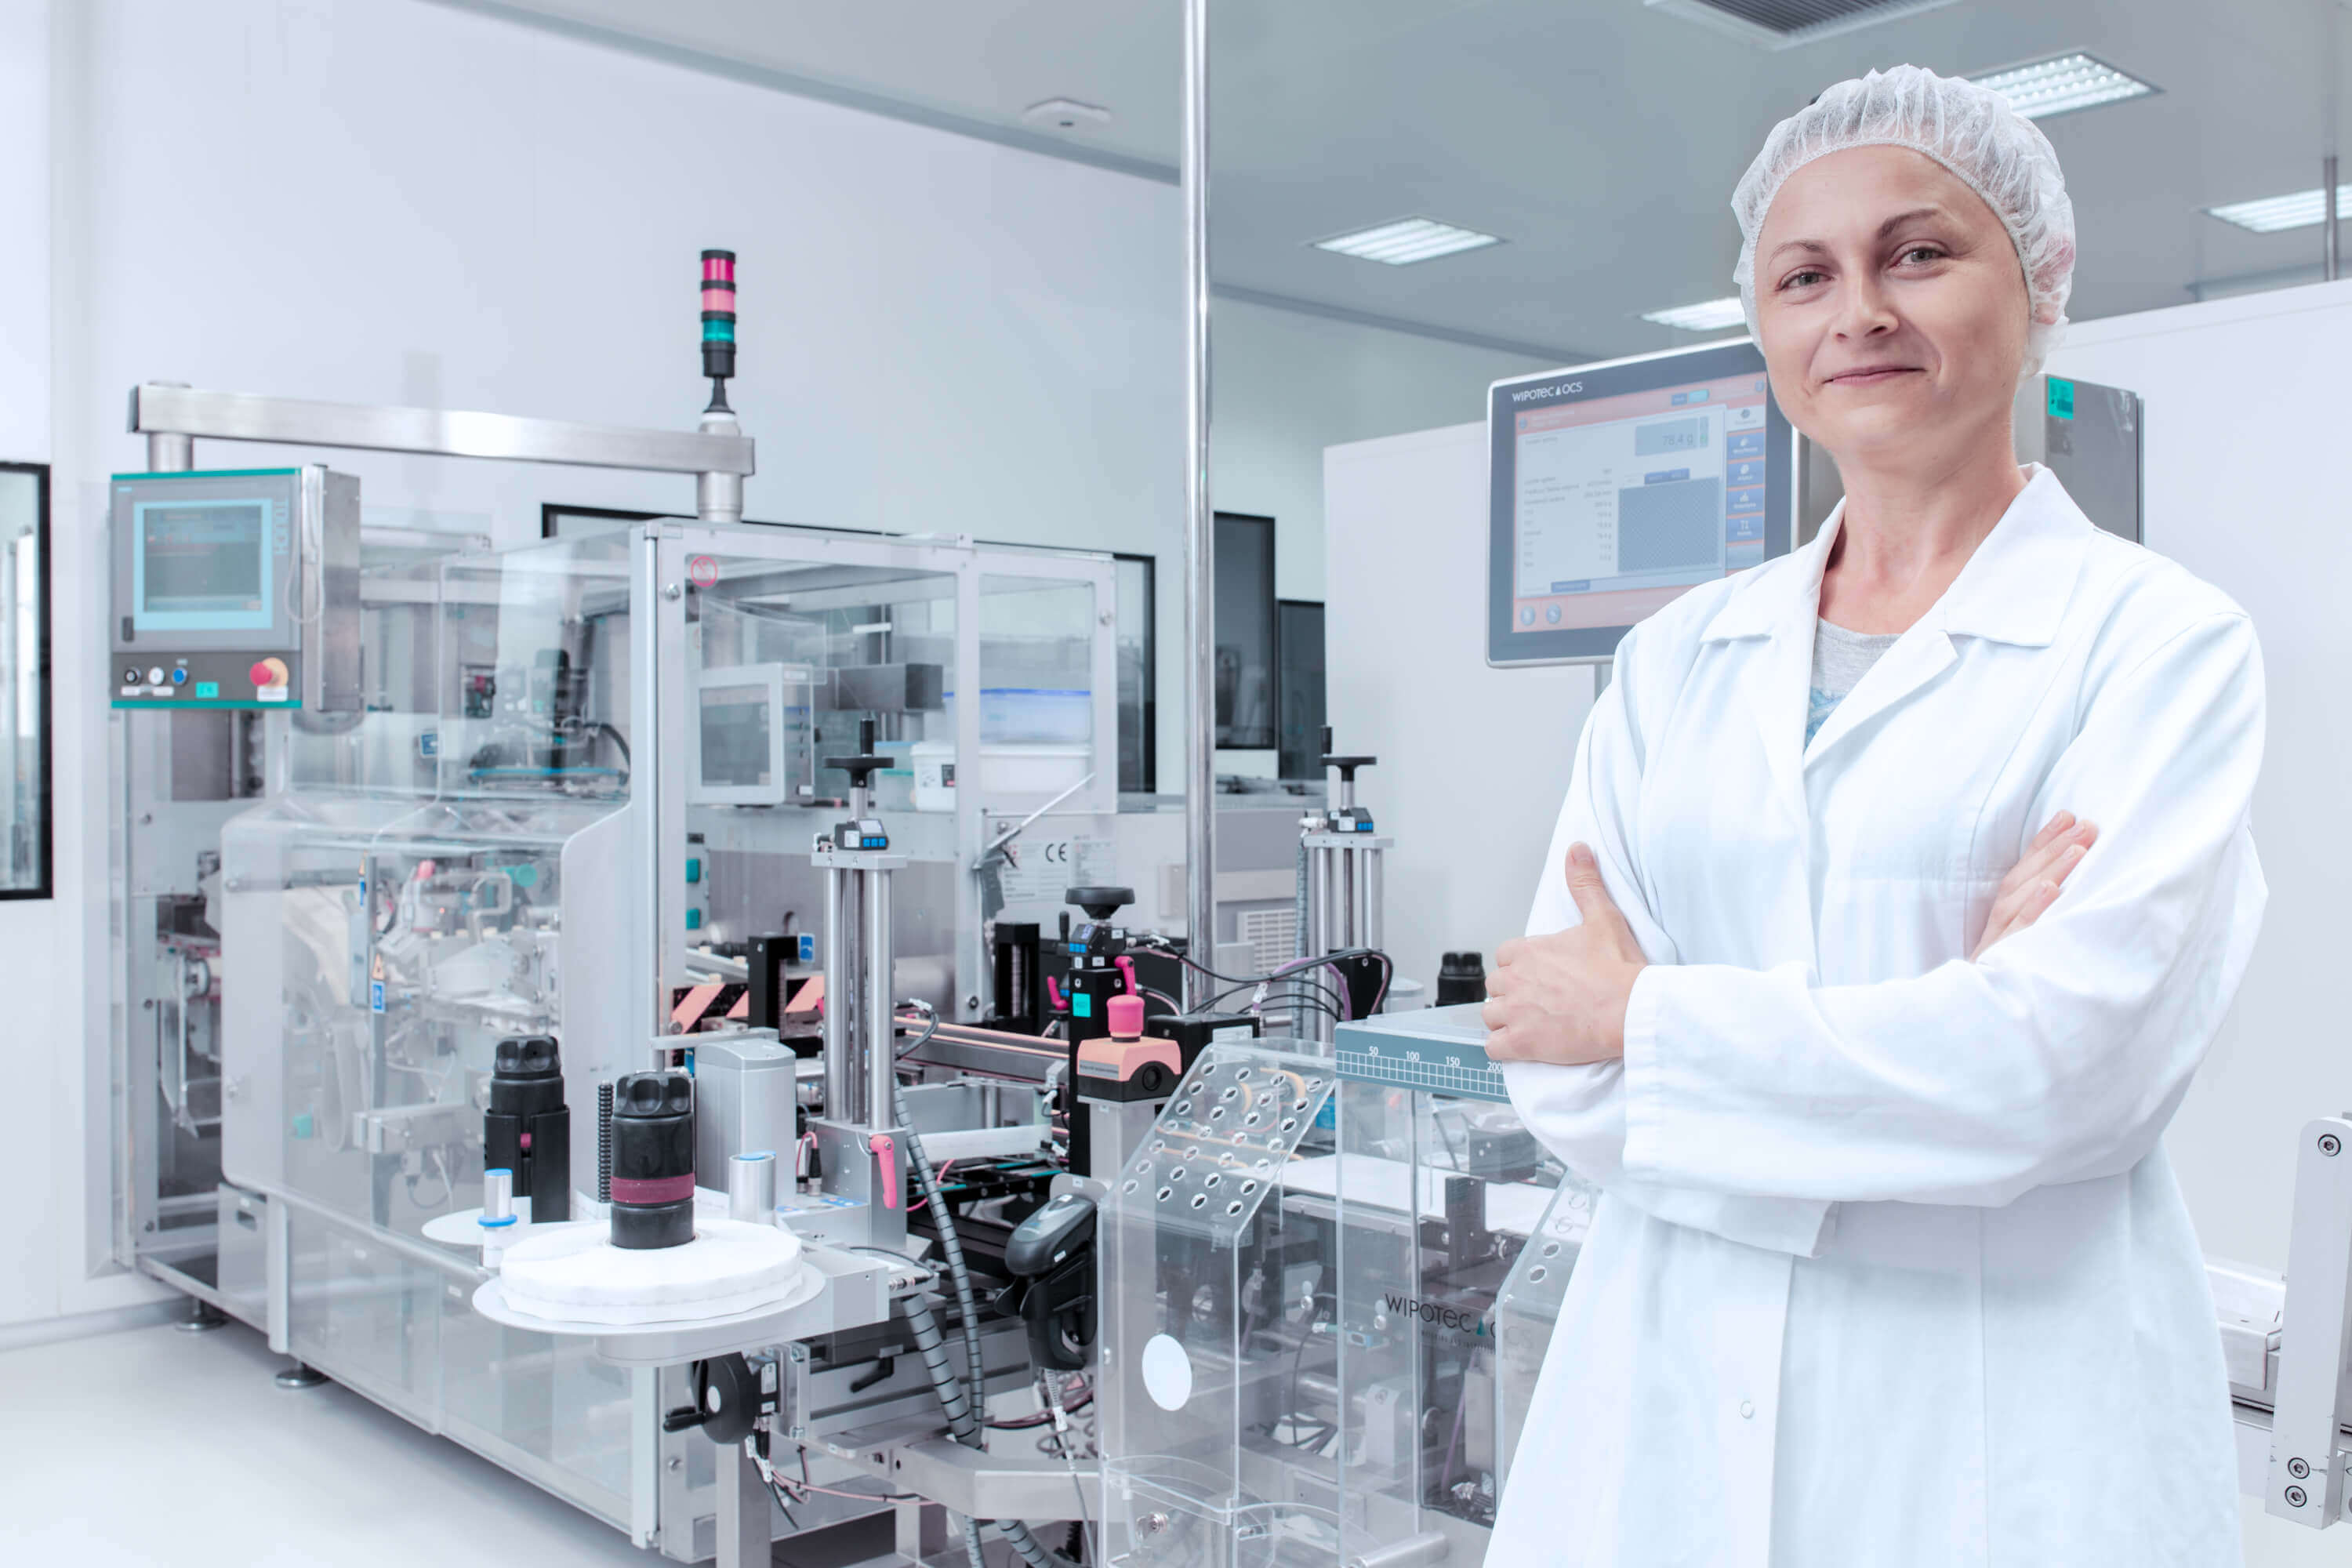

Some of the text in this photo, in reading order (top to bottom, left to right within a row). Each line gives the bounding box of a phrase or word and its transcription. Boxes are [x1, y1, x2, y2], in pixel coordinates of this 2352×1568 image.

[1562, 381, 1583, 394] OCS
[1369, 1046, 1502, 1073] 50 100 150 200
